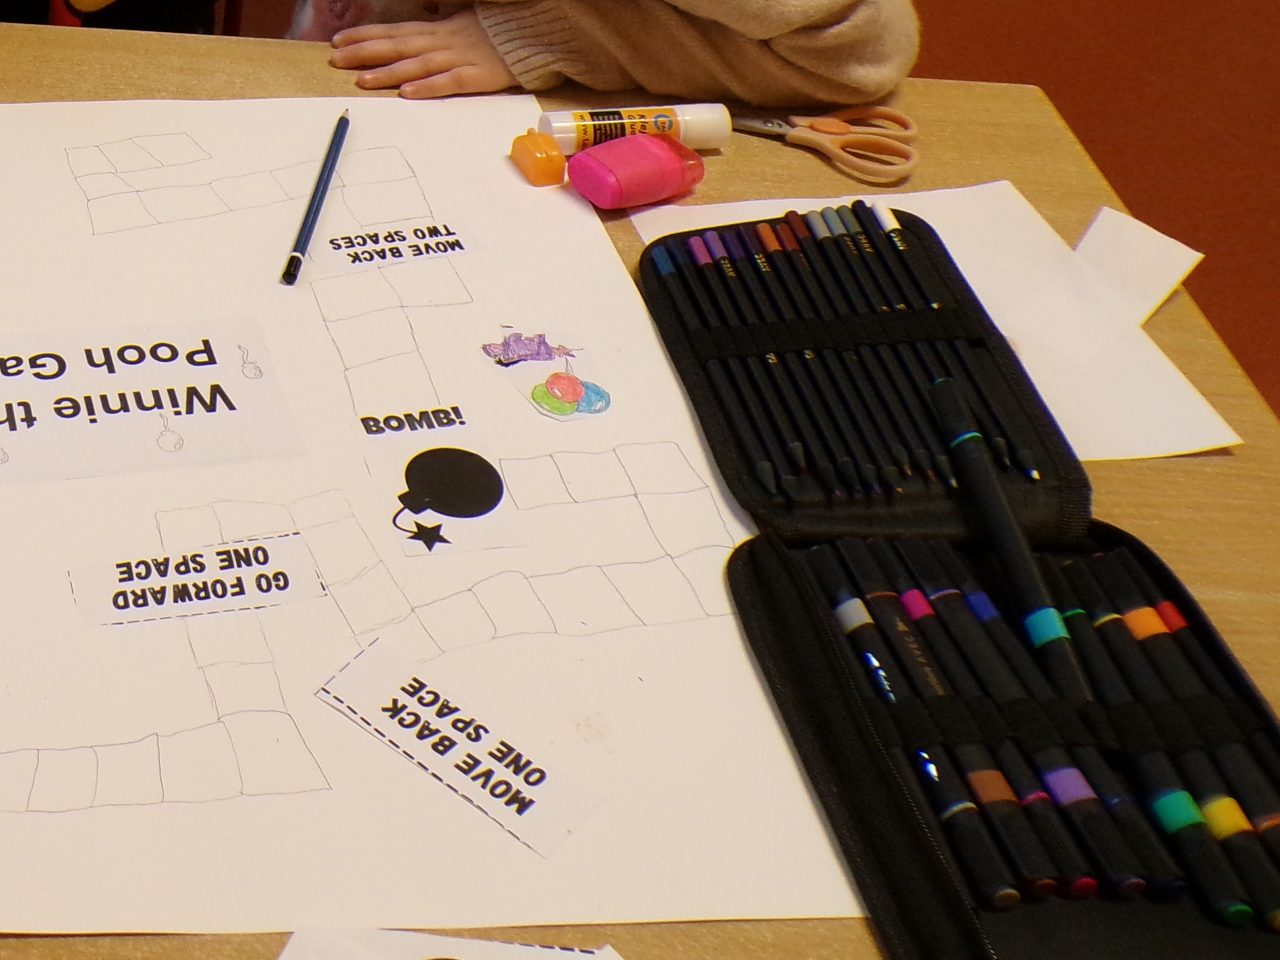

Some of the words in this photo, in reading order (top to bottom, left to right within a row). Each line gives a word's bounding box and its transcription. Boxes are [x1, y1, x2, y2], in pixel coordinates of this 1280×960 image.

[328, 230, 407, 251] SPACES
[413, 225, 457, 240] TWO
[347, 247, 403, 263] BACK
[408, 240, 465, 256] MOVE
[85, 339, 218, 374] Pooh
[54, 384, 237, 424] Winnie
[360, 406, 466, 435] BOMB!
[116, 553, 207, 582] SPACE
[216, 546, 269, 570] ONE
[112, 576, 246, 610] FORWARD
[255, 571, 290, 594] GO
[400, 677, 490, 743] SPACE
[381, 698, 457, 756] BACK
[488, 741, 547, 787] ONE
[453, 753, 535, 817] MOVE
